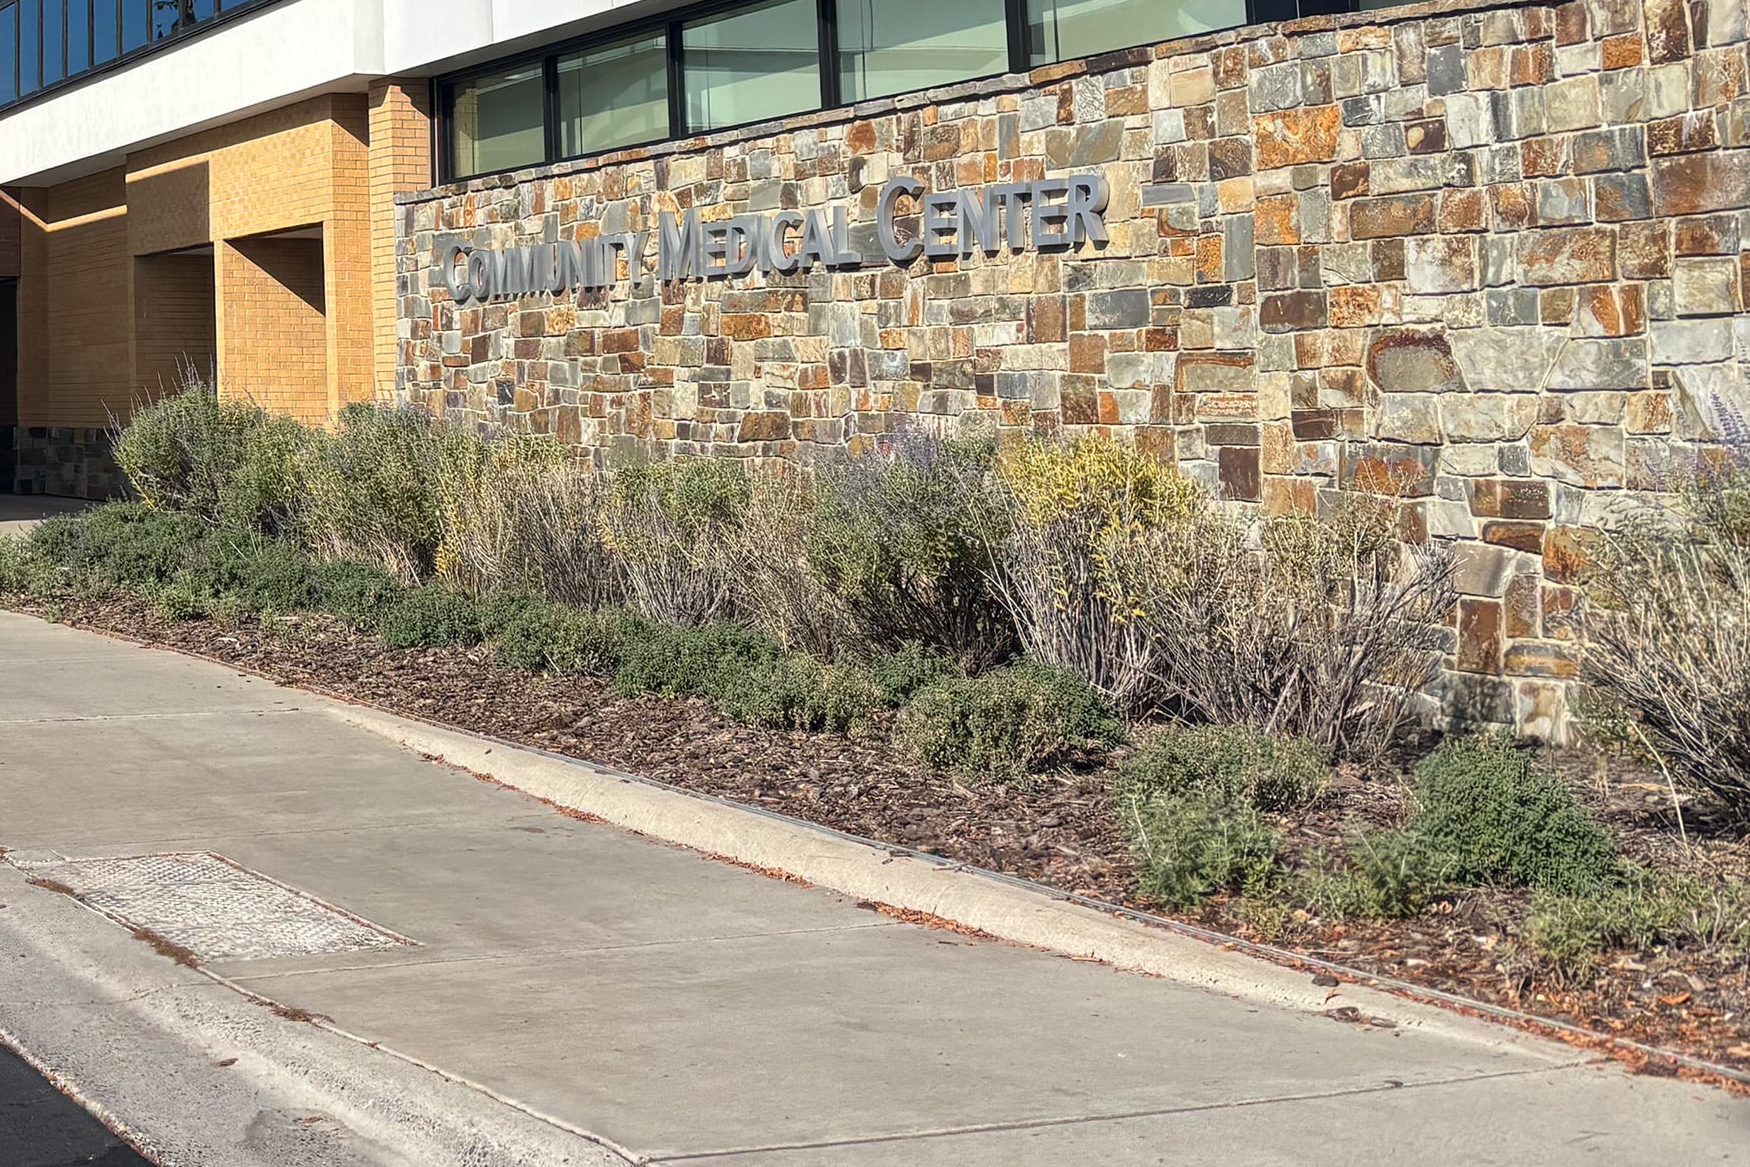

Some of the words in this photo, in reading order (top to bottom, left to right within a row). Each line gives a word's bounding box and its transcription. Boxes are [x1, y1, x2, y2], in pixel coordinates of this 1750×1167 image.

[443, 236, 650, 300] COMMUNITY
[658, 206, 863, 280] MEDICAL
[877, 175, 1110, 261] CENTER
